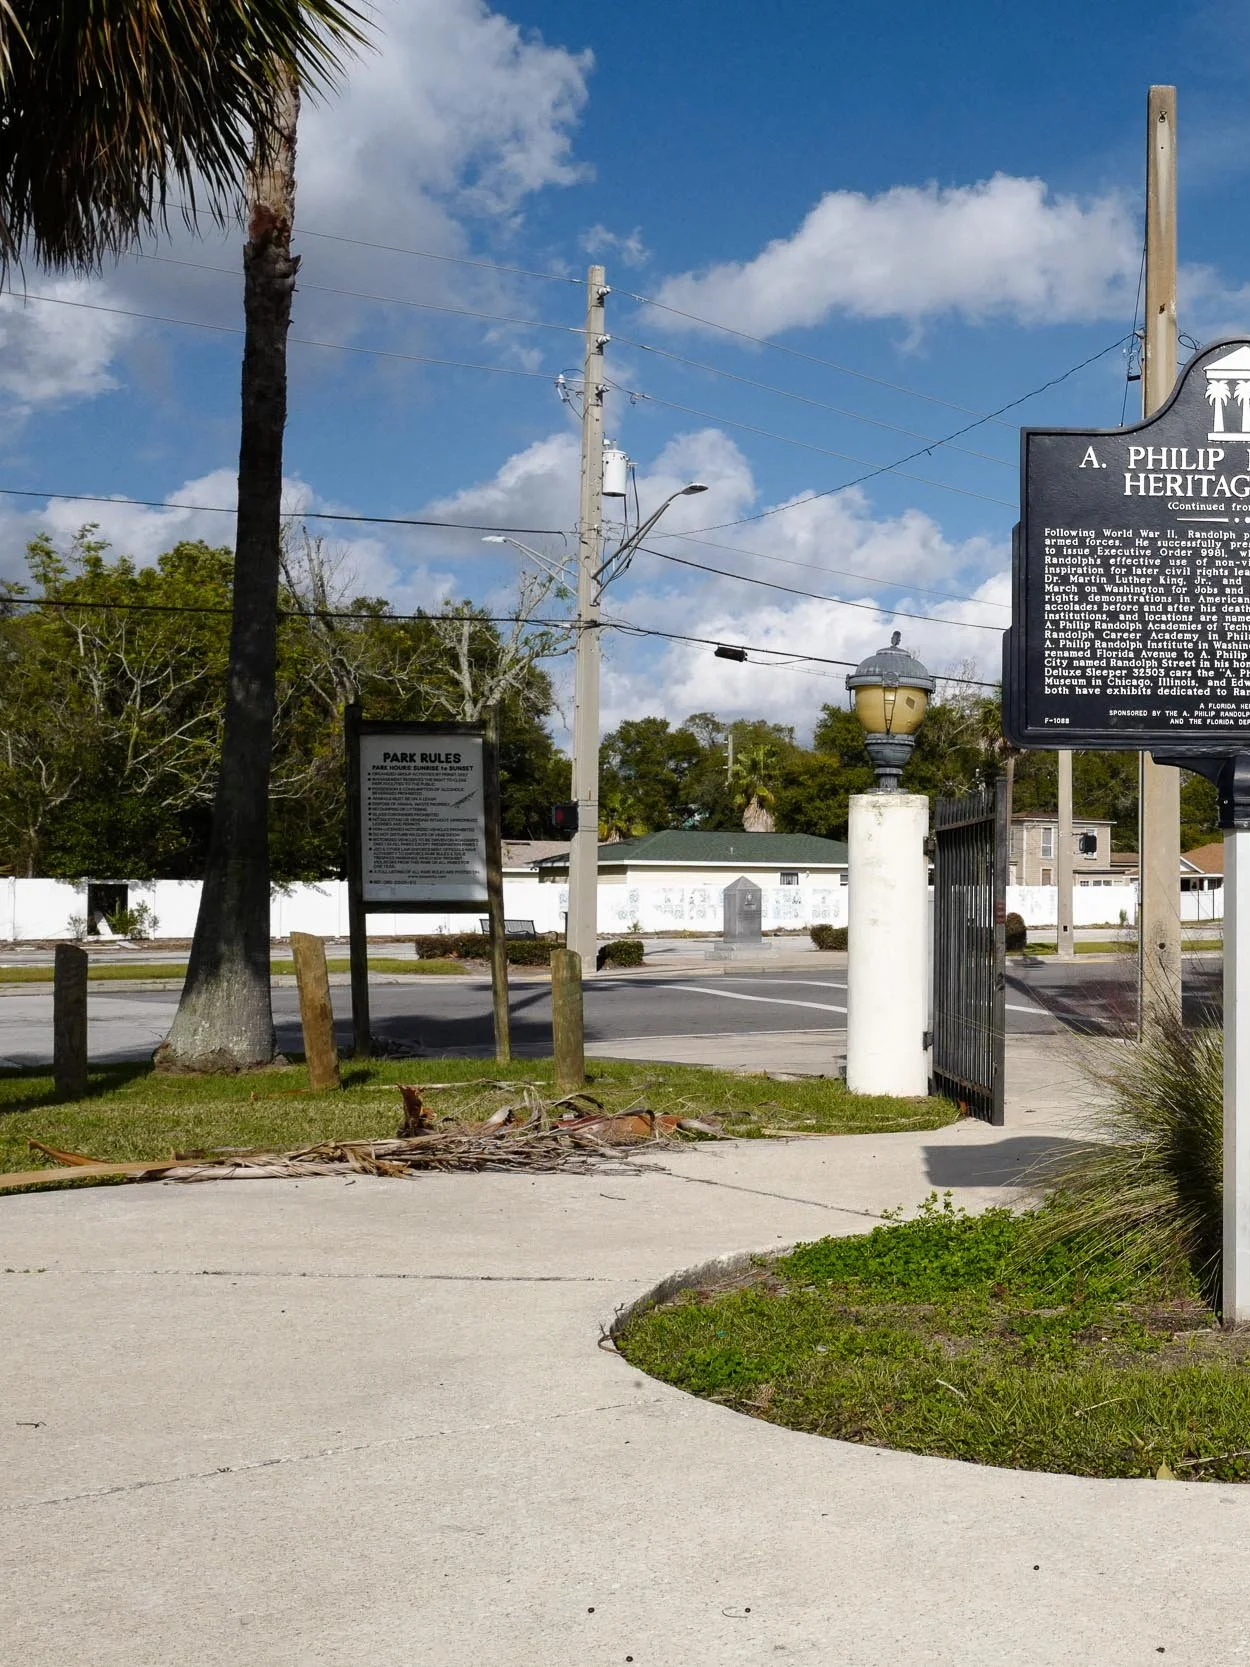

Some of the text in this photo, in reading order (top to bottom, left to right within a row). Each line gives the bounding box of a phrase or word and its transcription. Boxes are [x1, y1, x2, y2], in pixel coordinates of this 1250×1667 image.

[1079, 446, 1106, 469] A.
[1128, 447, 1224, 471] PHILIP
[1168, 502, 1224, 511] (Continued
[1044, 528, 1094, 538] Following
[1188, 530, 1235, 540] Randolph
[1157, 539, 1221, 549] successfully
[1097, 547, 1151, 555] Executive
[1044, 556, 1100, 566] Randolph's
[1109, 557, 1160, 565] effective
[1044, 565, 1104, 576] inspiration
[1196, 568, 1228, 578] rights
[1104, 584, 1164, 595] Washington
[1045, 593, 1078, 603] rights
[1088, 594, 1172, 602] demonstrations
[1044, 602, 1097, 610] accolades
[1102, 602, 1138, 611] before
[1167, 603, 1195, 611] after
[1221, 604, 1250, 612] death
[1118, 612, 1138, 620] and
[1145, 612, 1192, 620] locations
[1060, 620, 1090, 631] Philip
[1094, 621, 1142, 631] Randolph
[1147, 621, 1201, 630] Academies
[1044, 630, 1198, 641] Randolph Career Academy
[1059, 639, 1090, 649] Philip
[1094, 639, 1142, 650] Randolph
[1147, 640, 1193, 648] Institute
[1044, 648, 1090, 657] renamed
[1096, 649, 1134, 657] Florida
[1140, 649, 1176, 657] Avenue
[1216, 650, 1247, 660] Philip
[1044, 657, 1068, 668] City
[1073, 658, 1106, 666] named
[1110, 658, 1157, 668] Randolph
[1161, 658, 1195, 667] Street
[1044, 667, 1081, 675] Deluxe
[1085, 667, 1127, 678] Sleeper
[1132, 668, 1164, 676] 32503
[1044, 676, 1086, 685] Museum
[1044, 686, 1068, 694] both
[1106, 686, 1150, 694] exhibits
[1157, 686, 1210, 695] dedicated
[383, 752, 461, 763] PARK RULES
